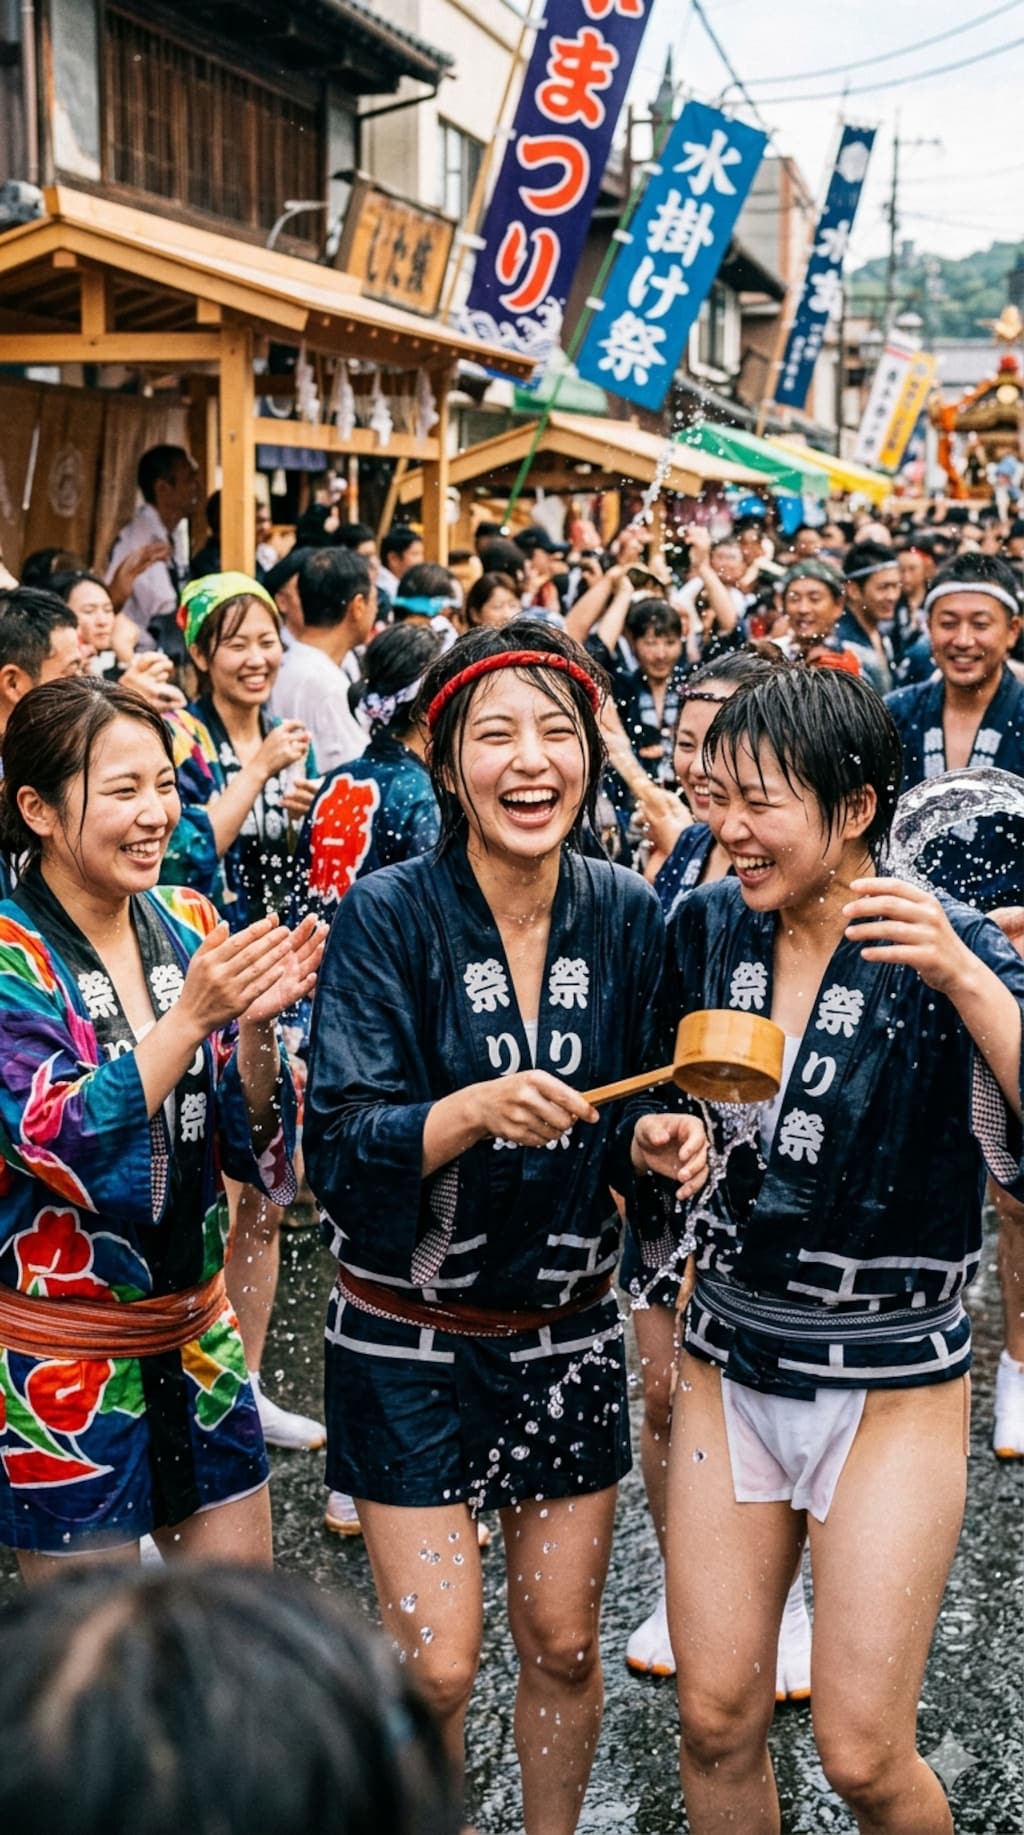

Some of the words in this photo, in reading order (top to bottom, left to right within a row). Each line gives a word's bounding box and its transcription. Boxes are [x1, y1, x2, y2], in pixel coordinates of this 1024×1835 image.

[496, 0, 644, 313] まつり
[598, 129, 742, 387] 水掛け祭
[463, 957, 522, 1150] 祭り
[547, 956, 592, 1150] 祭り
[777, 983, 866, 1165] 祭り祭
